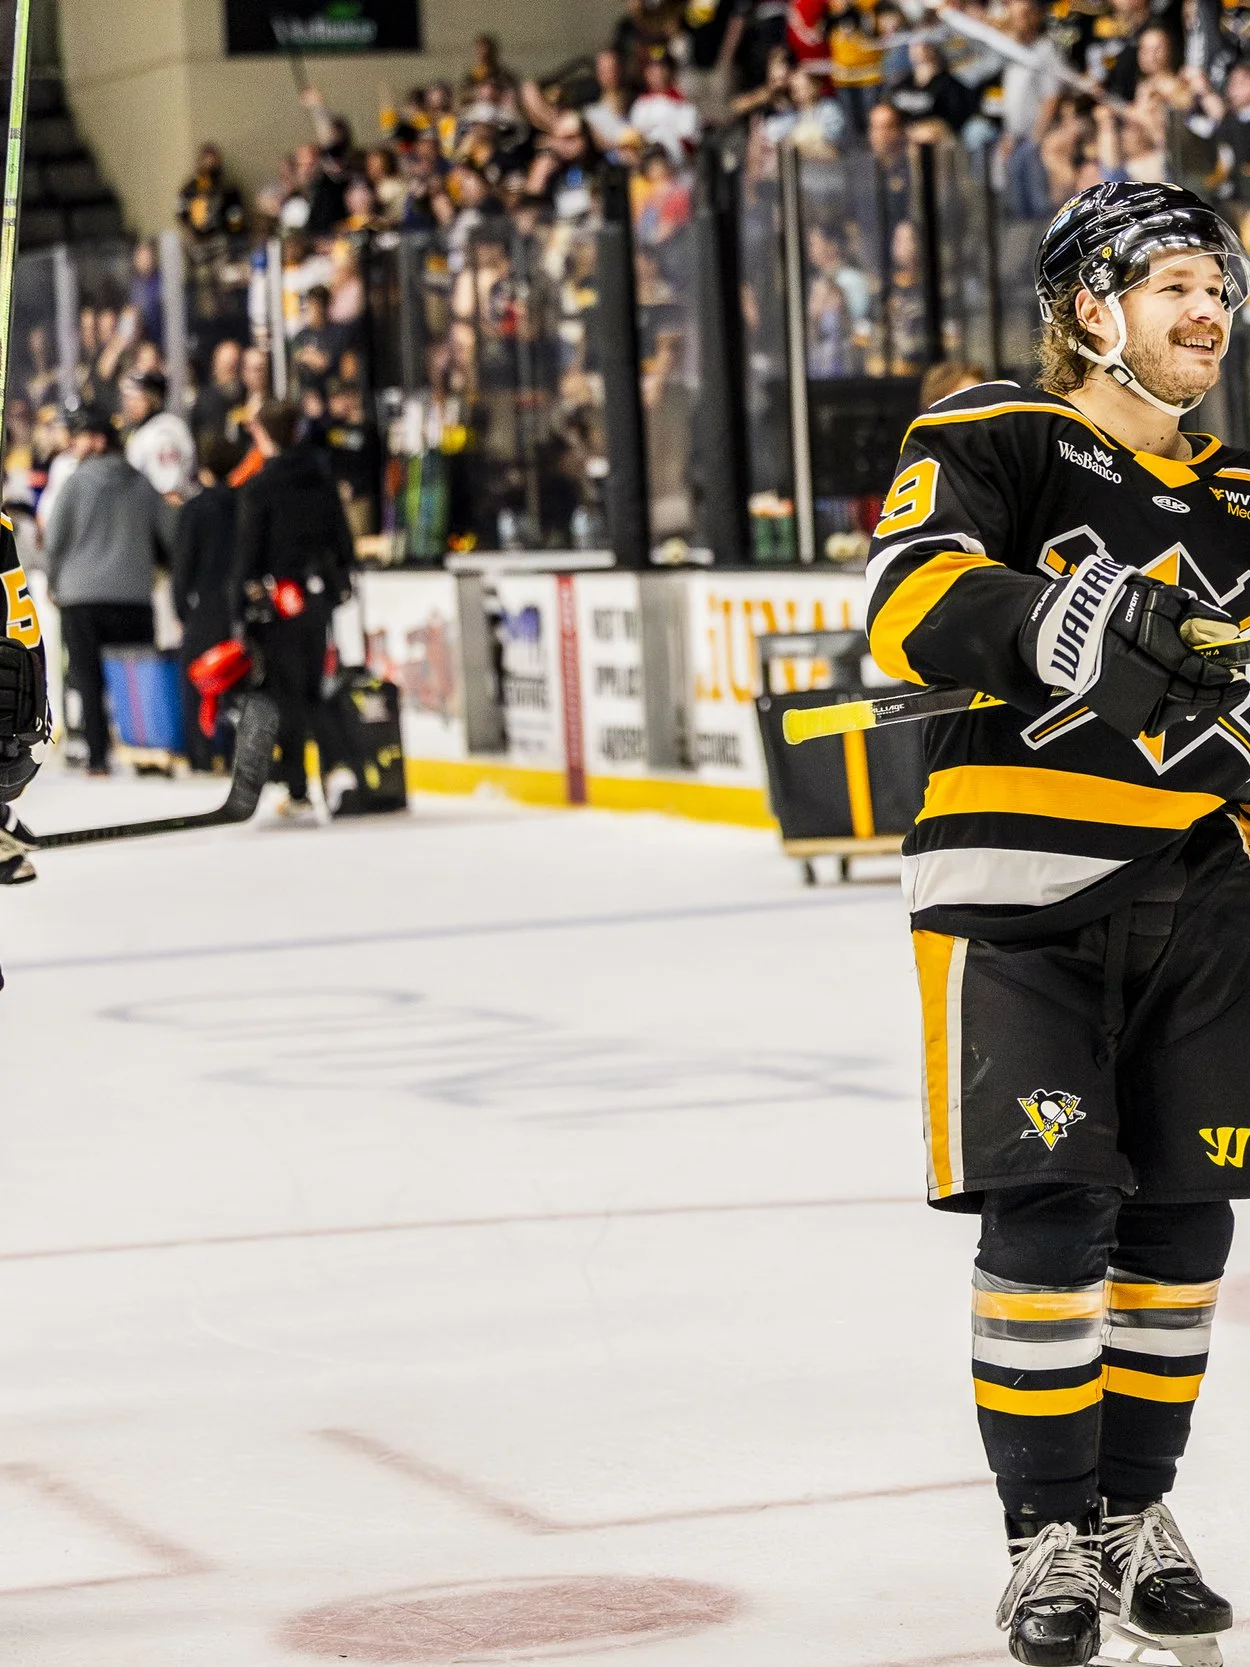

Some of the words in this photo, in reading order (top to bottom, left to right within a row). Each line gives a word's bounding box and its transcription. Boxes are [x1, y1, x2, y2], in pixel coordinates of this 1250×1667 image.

[1057, 440, 1122, 484] WesBanco
[872, 457, 940, 539] 9
[1125, 591, 1140, 622] COVERT
